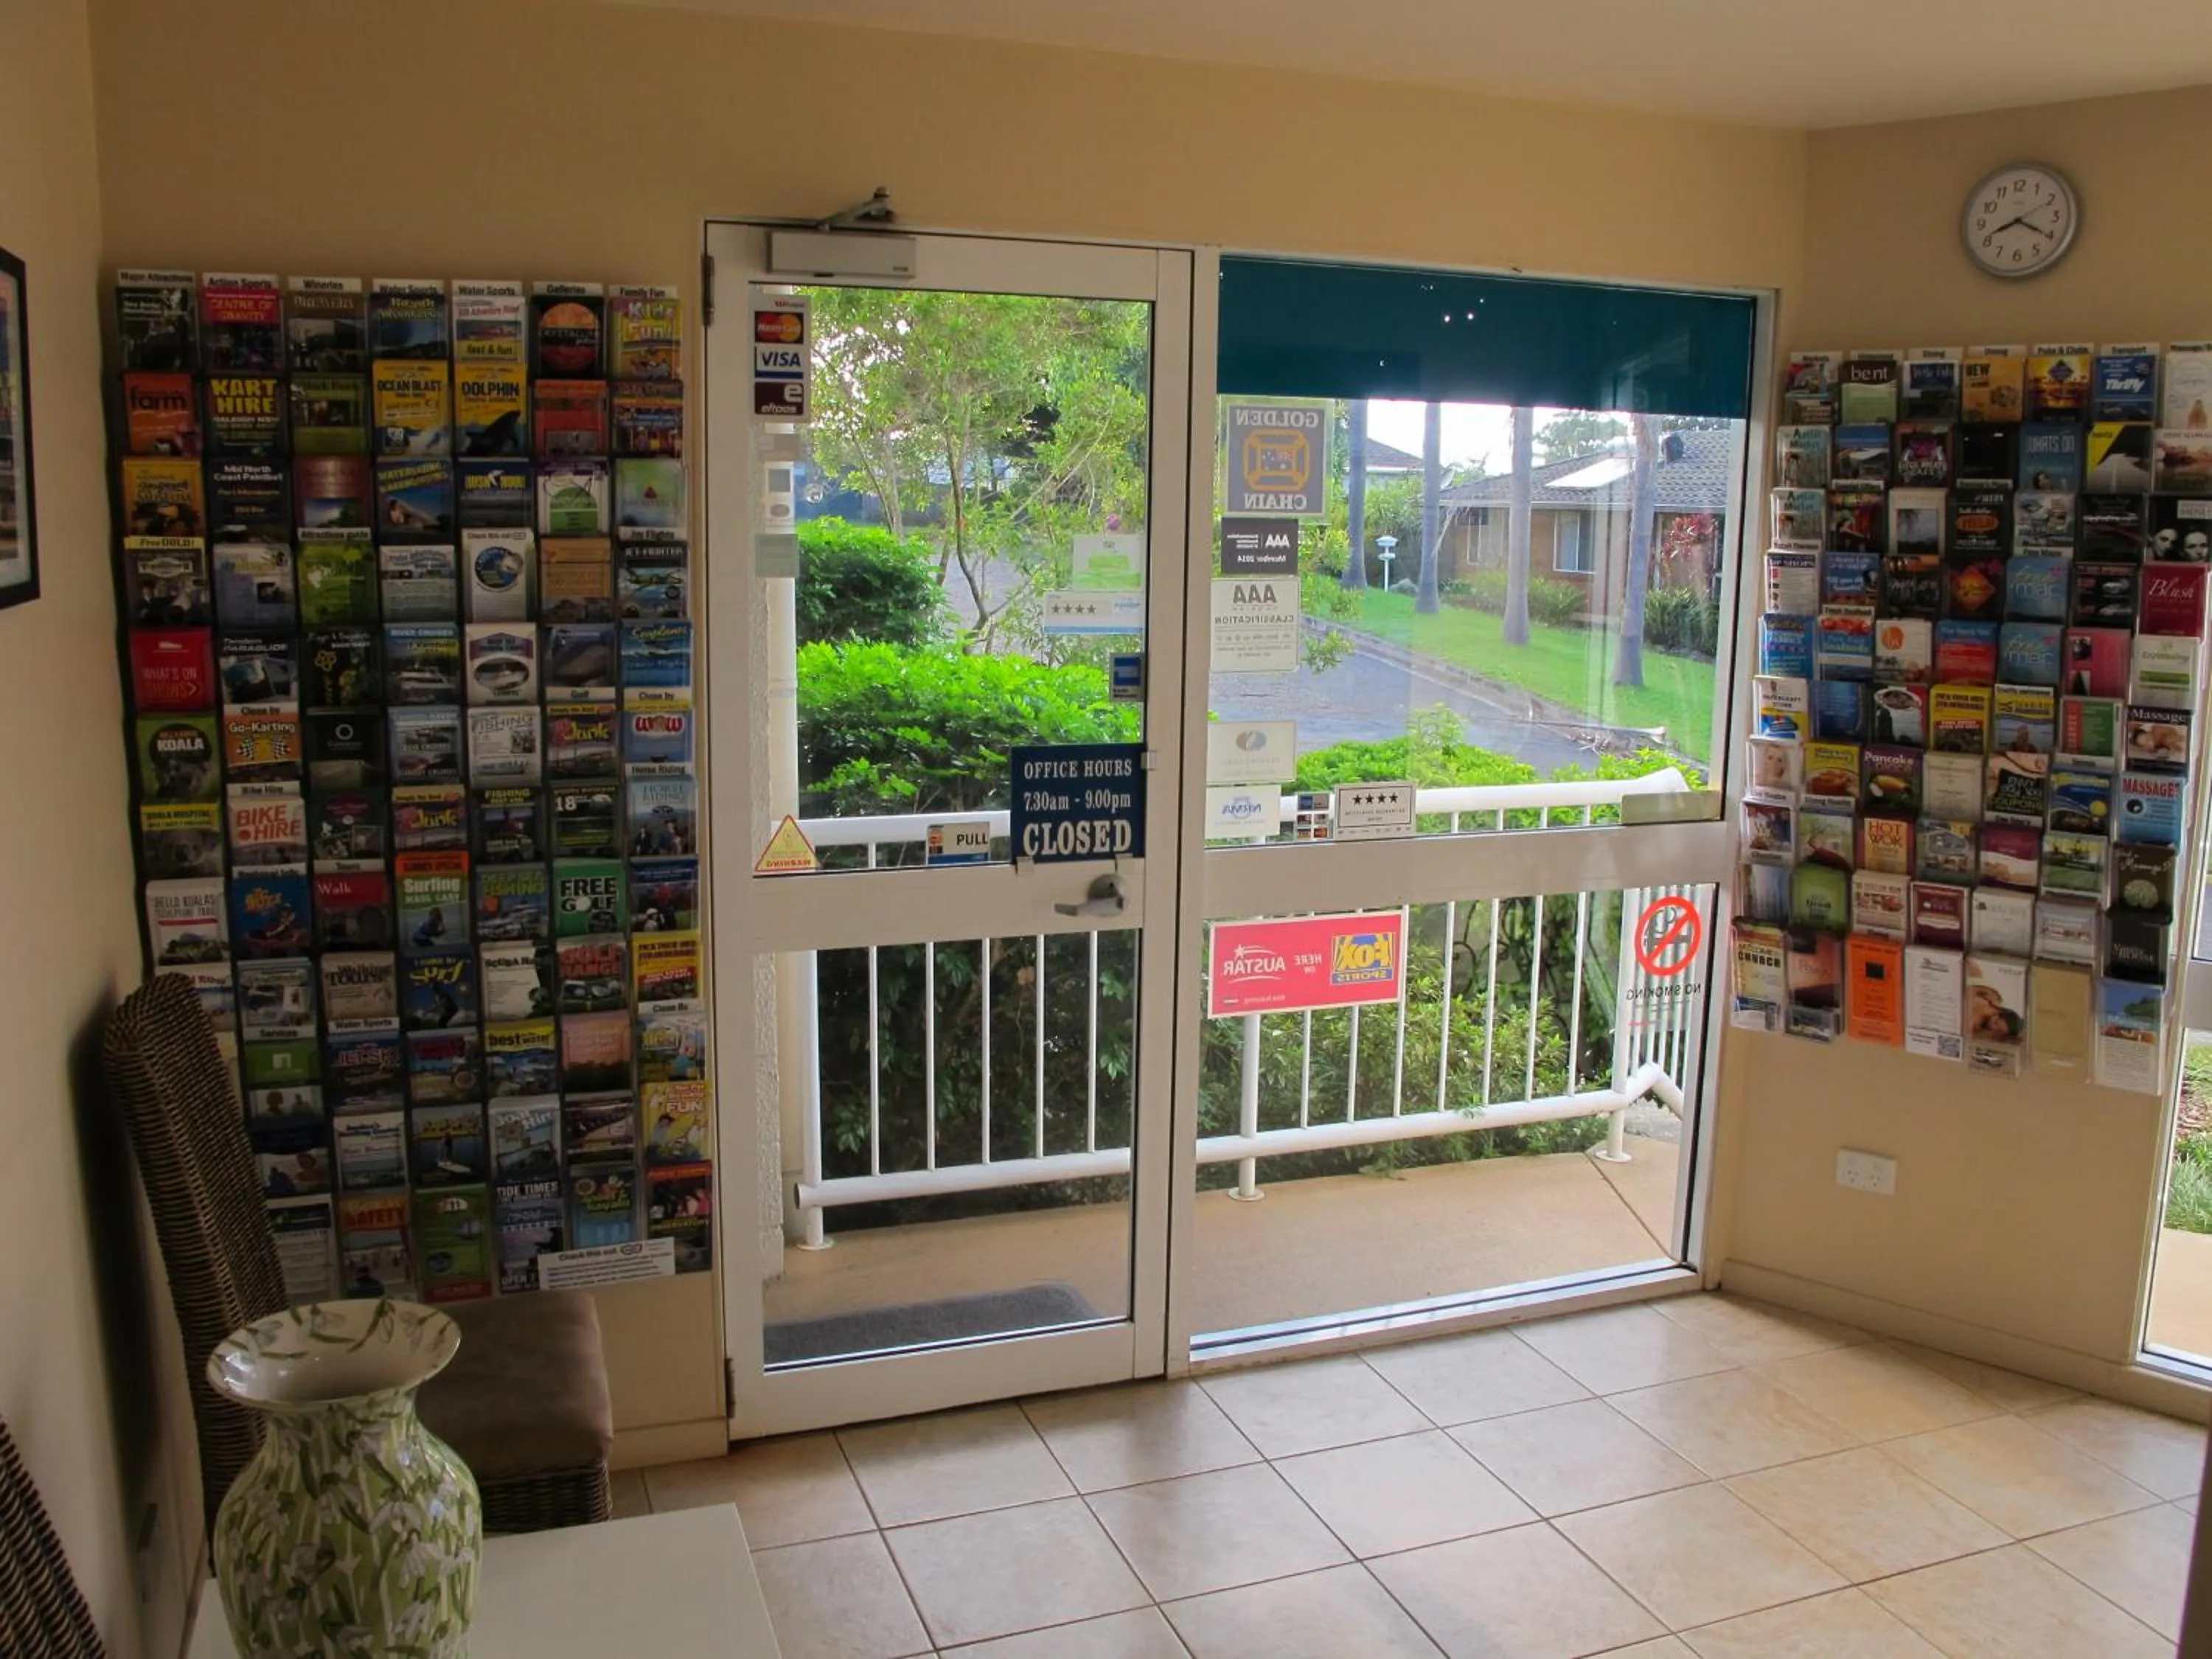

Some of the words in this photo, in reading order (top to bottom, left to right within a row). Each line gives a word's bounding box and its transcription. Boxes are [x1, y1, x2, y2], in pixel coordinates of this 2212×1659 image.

[1996, 186, 2007, 199] 11
[2013, 179, 2026, 192] 12
[2034, 182, 2039, 195] 1
[2045, 193, 2056, 206] 2
[1984, 201, 1997, 214] 10
[2051, 210, 2060, 223] 3
[1977, 218, 1986, 231] 9
[1983, 234, 1992, 248] 8
[2044, 230, 2053, 240] 4
[1996, 246, 2004, 258] 7
[2012, 248, 2023, 262] 6
[2032, 243, 2040, 257] 5
[147, 273, 193, 282] Attractions
[208, 277, 237, 288] Action
[241, 279, 271, 290] Sports
[304, 280, 344, 290] Wineries
[459, 286, 484, 295] Water
[486, 287, 515, 296] Sports
[546, 285, 585, 294] Galleries
[762, 352, 801, 366] VISA
[1851, 365, 1888, 381] bent
[1966, 364, 1990, 377] NEW
[211, 378, 278, 397] KART
[413, 380, 442, 392] BLAST
[462, 381, 519, 396] DOLPHIN
[2104, 378, 2144, 393] Thrifty
[130, 386, 186, 411] farm
[217, 397, 275, 414] HIRE
[301, 531, 342, 540] Attractions
[345, 530, 369, 540] guide
[2148, 577, 2195, 599] Blush
[184, 667, 197, 679] ON
[571, 689, 588, 700] Golf
[2131, 707, 2186, 724] Massage
[229, 721, 295, 735] Go-Karting
[563, 720, 610, 740] Junk
[157, 737, 205, 751] KOALA
[1864, 750, 1914, 765] Pancake
[658, 764, 686, 776] Riding
[1023, 760, 1077, 779] OFFICE
[1083, 759, 1133, 777] HOURS
[265, 785, 284, 795] Hire
[555, 794, 577, 812] 18
[1023, 791, 1069, 812] 7.30am
[1085, 788, 1132, 814] 9.00pm
[235, 804, 288, 828] BIKE
[414, 806, 457, 827] Junk
[255, 820, 302, 841] HIRE
[1868, 821, 1902, 835] HOT
[956, 832, 989, 846] PULL
[1022, 819, 1133, 857] CLOSED
[319, 881, 352, 895] Walk
[403, 879, 461, 894] Surfing
[560, 877, 617, 897] FREE
[259, 1029, 298, 1038] Services
[666, 1101, 703, 1113] FUN
[524, 1182, 559, 1196] TIMES
